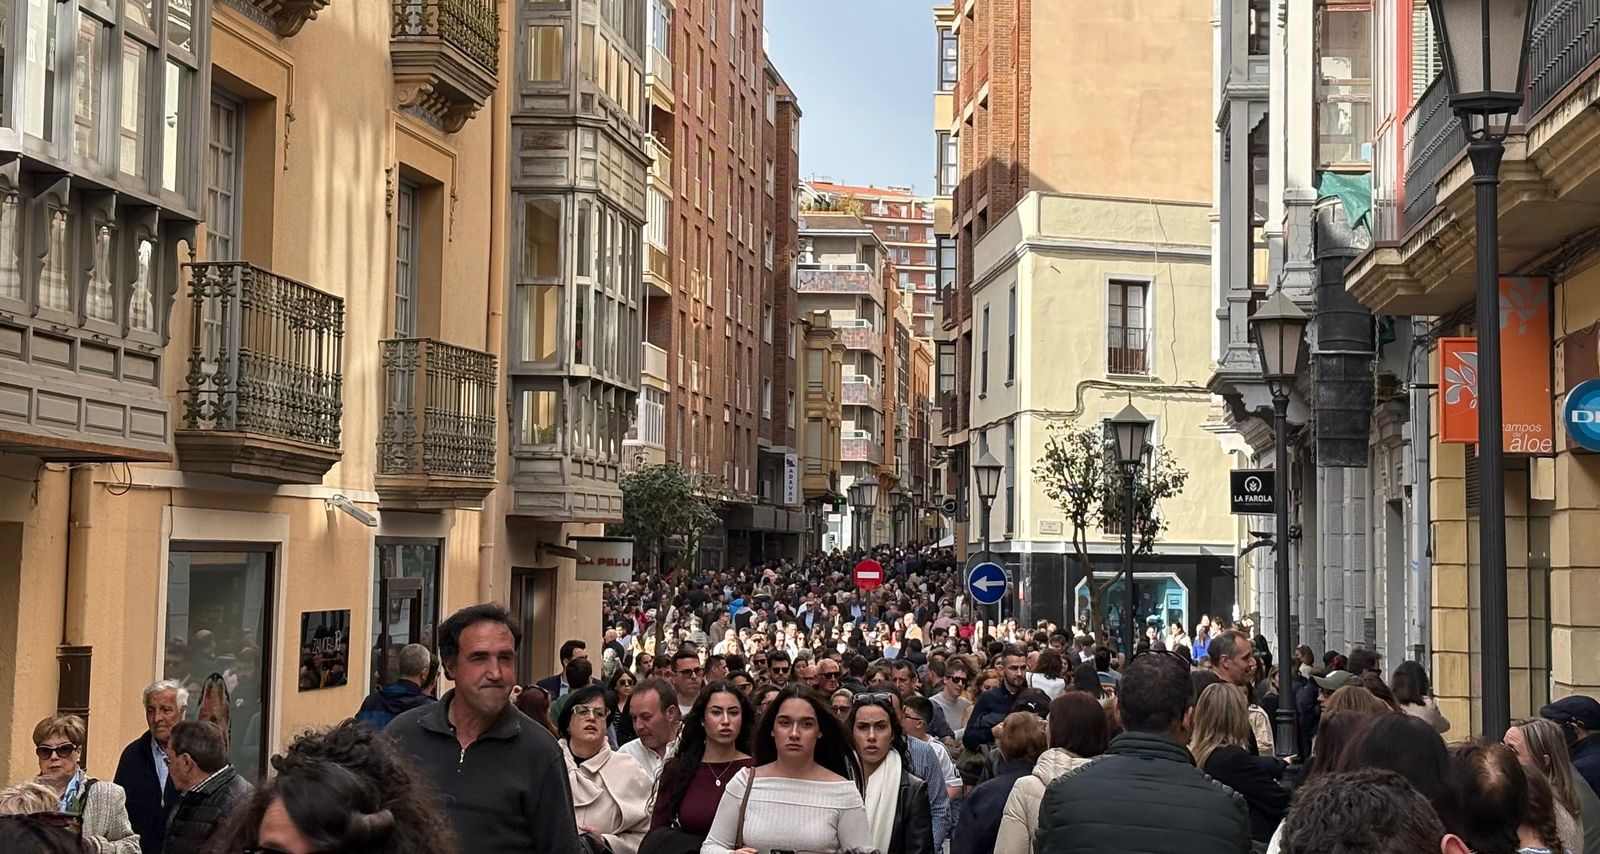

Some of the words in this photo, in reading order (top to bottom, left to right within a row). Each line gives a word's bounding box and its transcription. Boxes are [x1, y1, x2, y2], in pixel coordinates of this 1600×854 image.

[1510, 434, 1552, 452] aloe
[1234, 494, 1244, 502] LA
[1244, 494, 1272, 502] FAROLA
[598, 558, 630, 566] PELU
